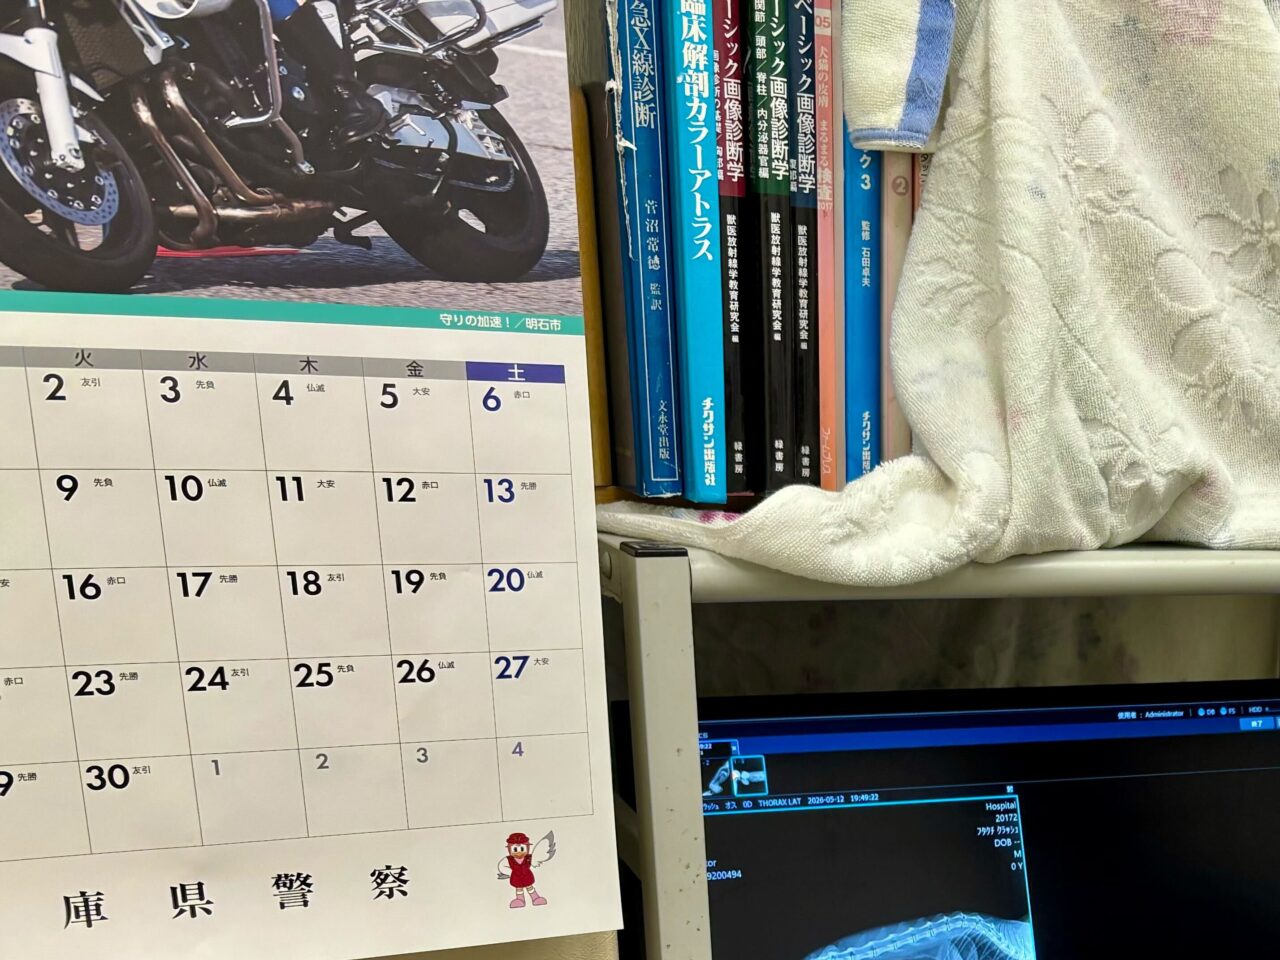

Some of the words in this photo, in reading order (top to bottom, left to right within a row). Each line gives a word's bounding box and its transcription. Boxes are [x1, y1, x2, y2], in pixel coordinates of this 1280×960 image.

[74, 348, 94, 368] 火
[188, 352, 209, 371] 水
[299, 356, 319, 374] 木
[405, 360, 424, 378] 金
[507, 363, 526, 381] 土
[42, 373, 67, 401] 2
[159, 375, 181, 404] 3
[272, 379, 294, 406] 4
[380, 382, 399, 409] 5
[482, 386, 502, 412] 6
[701, 397, 716, 486] チクサン出版社
[56, 474, 79, 502] 9
[164, 474, 204, 502] 10
[275, 476, 305, 502] 11
[381, 477, 417, 503] 12
[483, 478, 515, 504] 13
[62, 573, 102, 600] 16
[176, 571, 213, 598] 17
[286, 570, 322, 596] 18
[390, 569, 425, 594] 19
[487, 567, 525, 593] 20
[185, 666, 230, 692] 24
[293, 662, 334, 688] 25
[395, 658, 436, 686] 26
[494, 655, 530, 680] 27
[71, 670, 117, 698] 23
[315, 753, 330, 770] 2
[416, 747, 429, 764] 3
[511, 741, 525, 757] 4
[85, 763, 130, 791] 30
[211, 759, 220, 776] 1
[985, 801, 1017, 811] Hospital
[995, 813, 1018, 823] 20172
[994, 838, 1012, 848] DOB
[1013, 849, 1022, 858] M
